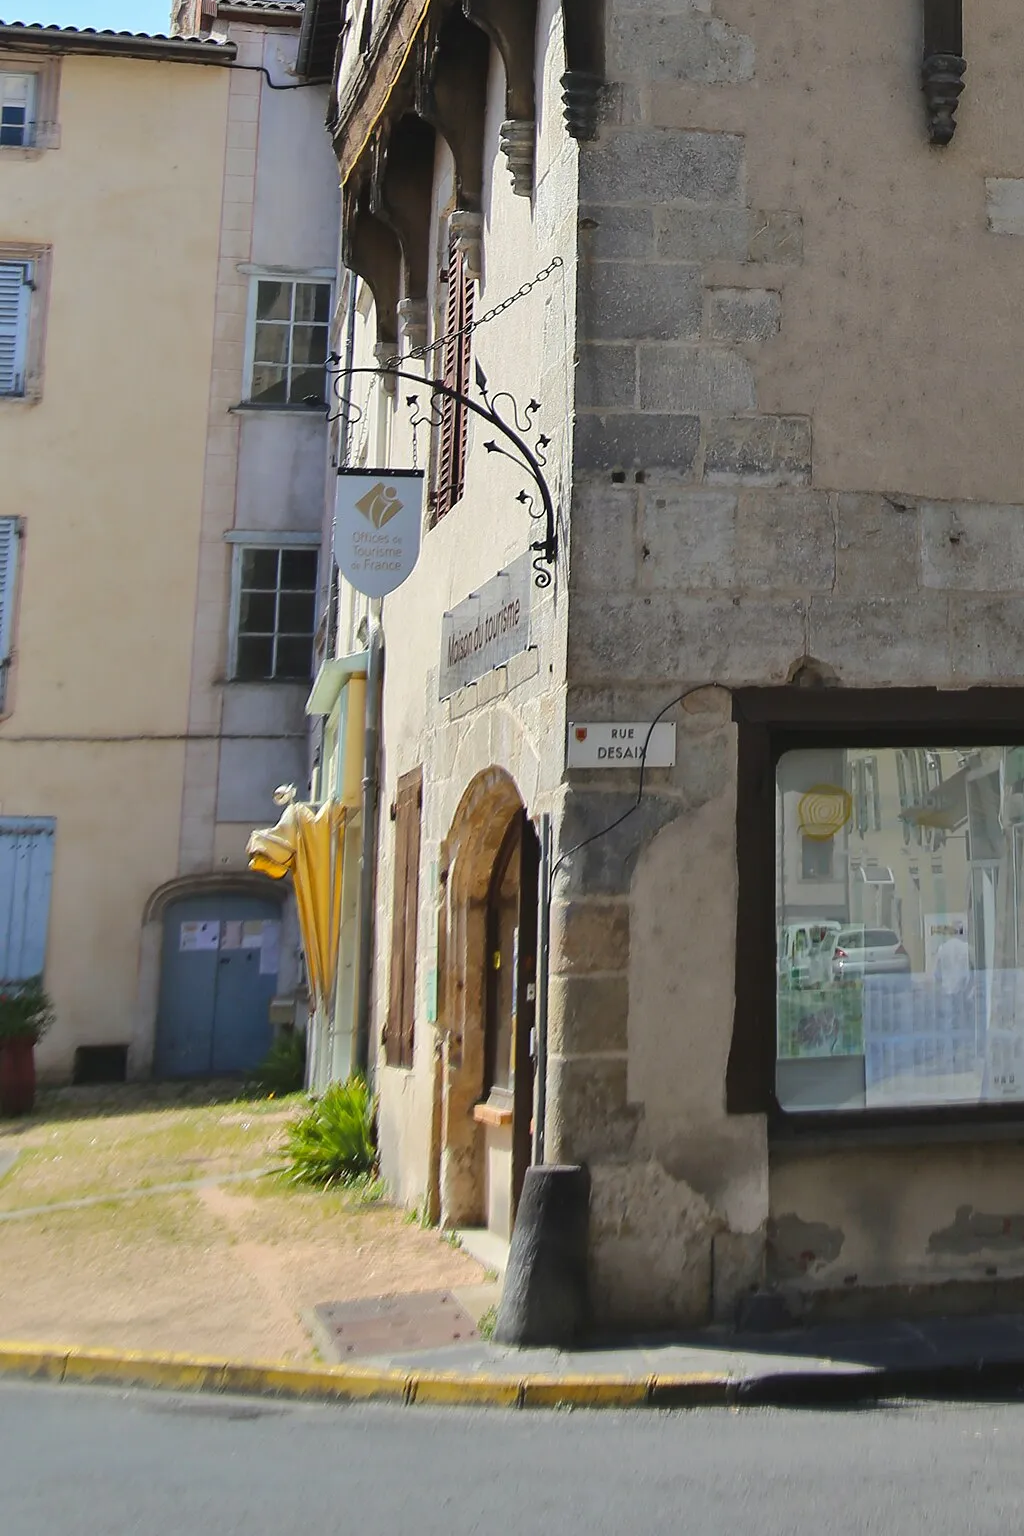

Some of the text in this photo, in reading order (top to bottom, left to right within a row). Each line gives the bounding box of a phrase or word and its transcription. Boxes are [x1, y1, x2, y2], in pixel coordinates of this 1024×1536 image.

[352, 531, 390, 544] Offices
[352, 544, 403, 557] Tourisme
[363, 558, 403, 571] France
[447, 598, 520, 668] Maison du tourisme
[611, 728, 635, 739] RUE
[597, 746, 647, 760] DESAIX
